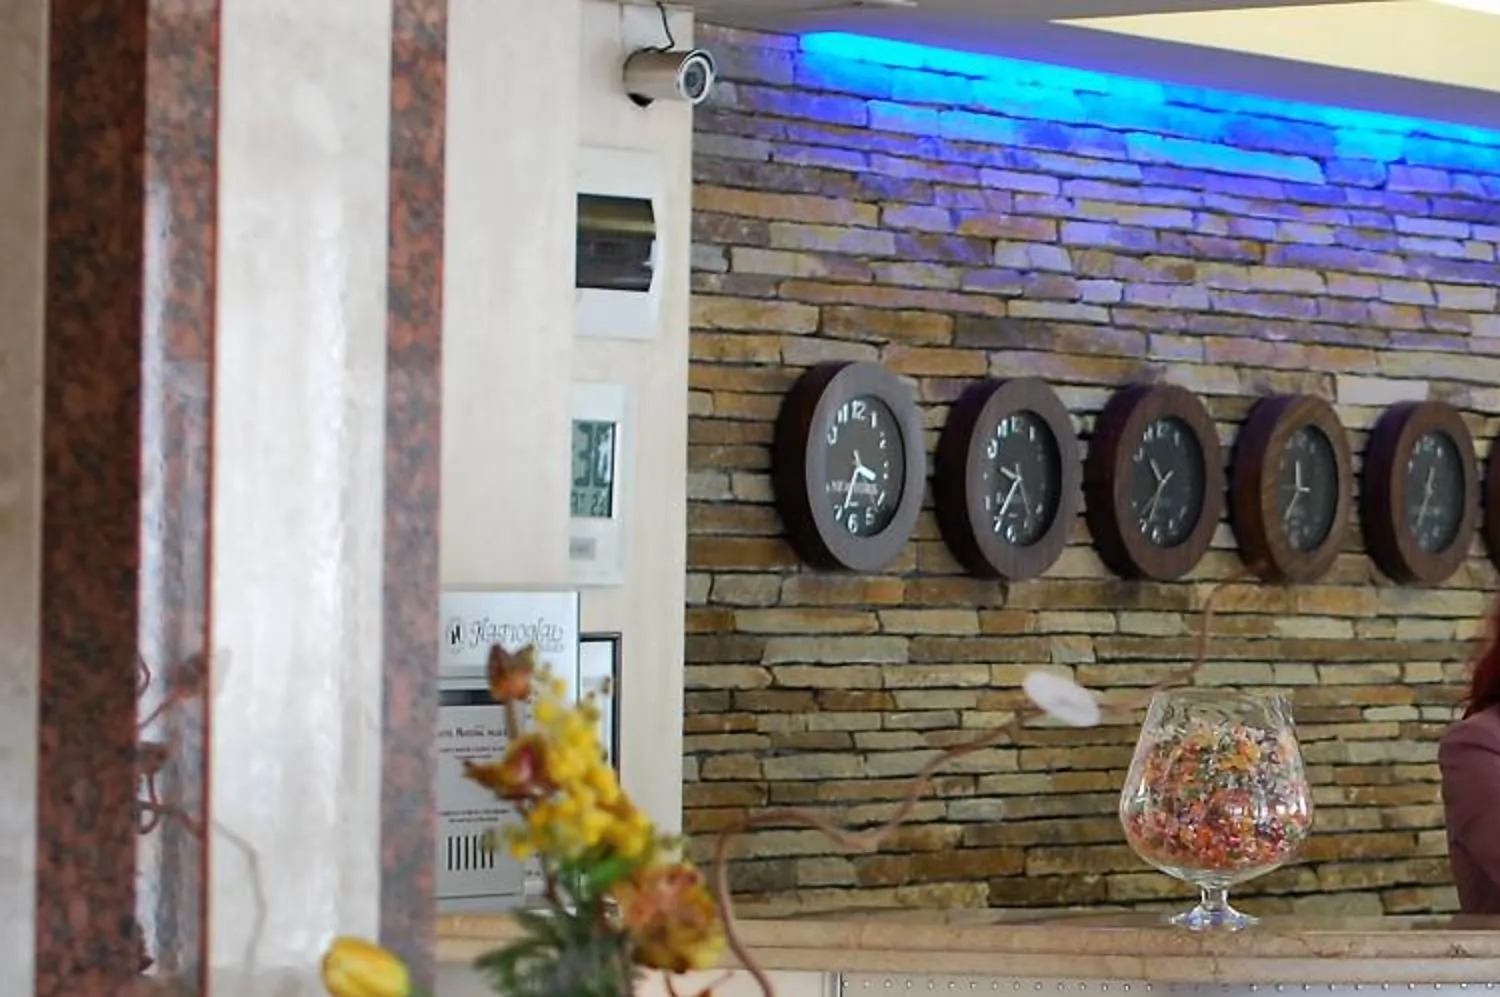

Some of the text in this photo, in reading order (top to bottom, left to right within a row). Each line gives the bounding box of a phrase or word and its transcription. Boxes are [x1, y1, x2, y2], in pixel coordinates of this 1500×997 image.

[851, 400, 866, 420] 12
[833, 503, 843, 521] 7
[848, 513, 859, 534] 6
